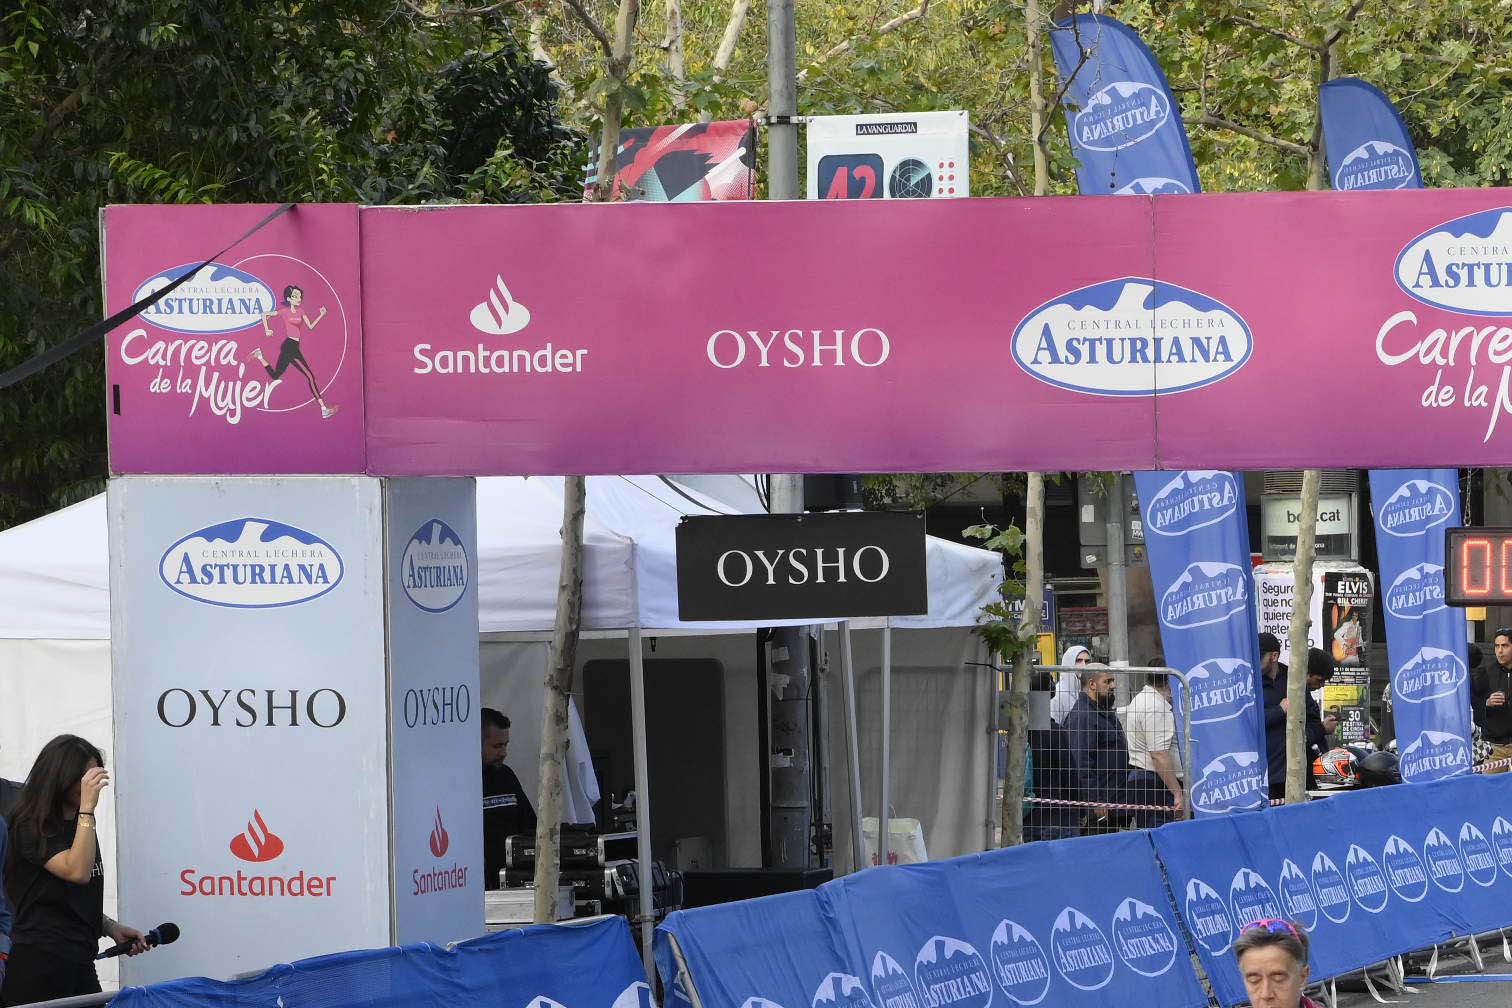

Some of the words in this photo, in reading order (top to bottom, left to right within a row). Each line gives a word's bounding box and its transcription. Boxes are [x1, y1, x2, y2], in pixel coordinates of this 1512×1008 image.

[866, 123, 917, 134] VANGUARDIA
[173, 286, 210, 295] ENTRAL
[1067, 319, 1142, 331] CENTRAL
[1150, 318, 1226, 329] LECHERA
[120, 328, 239, 367] Carrera
[413, 342, 588, 375] Santander
[706, 327, 891, 369] OYSHO
[1030, 322, 1235, 365] ASTURIANA
[149, 367, 172, 394] de
[176, 366, 192, 394] la
[189, 362, 283, 425] Mujer
[1421, 368, 1455, 408] de
[1463, 368, 1489, 408] la
[174, 551, 330, 585] ASTURIANA
[202, 549, 260, 559] CENTRAL
[265, 549, 324, 558] LECHERA
[717, 545, 890, 588] OYSHO
[406, 557, 465, 590] ASTURIANA
[1337, 580, 1368, 594] ELVIS
[1262, 599, 1279, 608] que
[156, 688, 347, 728] OYSHO
[403, 684, 471, 729] OYSHO
[1348, 710, 1360, 721] 30
[179, 869, 337, 897] Santander
[412, 863, 468, 896] Santander
[996, 955, 1048, 987] ASTURIANA
[1057, 940, 1112, 973] ASTURIANA
[920, 972, 990, 1008] ASTURIANA
